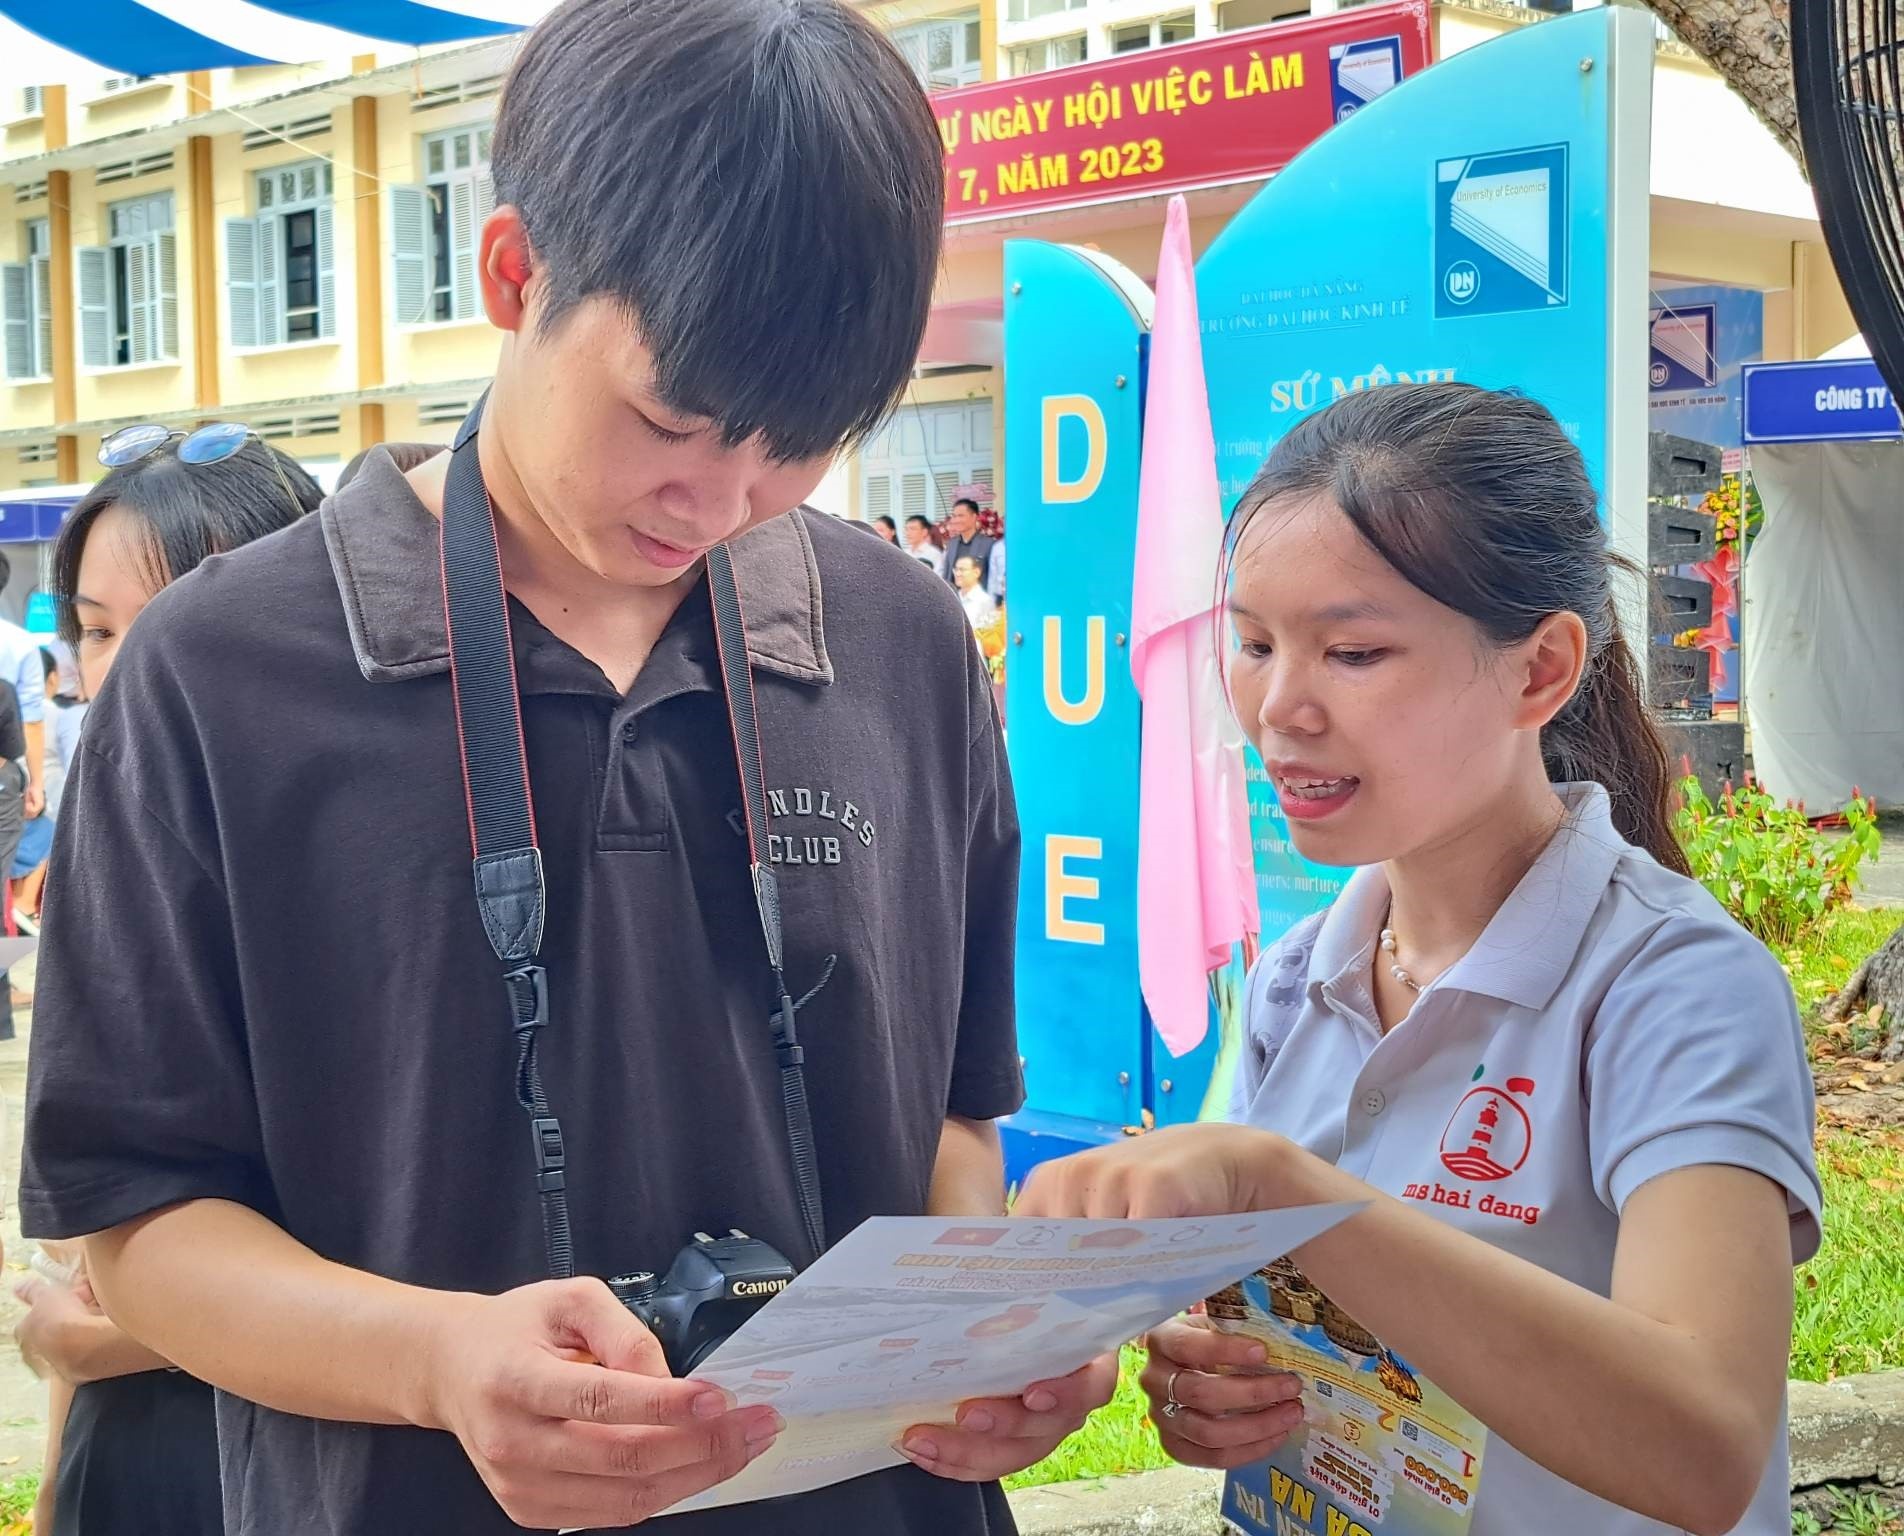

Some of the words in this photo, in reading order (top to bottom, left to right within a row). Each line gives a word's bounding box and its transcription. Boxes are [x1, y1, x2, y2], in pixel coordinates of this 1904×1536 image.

[971, 95, 1053, 144] NGÀY
[1063, 80, 1121, 130] HỘI
[1131, 65, 1213, 116] VIỆC
[1224, 51, 1304, 100] LÀM
[958, 168, 988, 205] 7,
[997, 152, 1069, 196] NĂM
[1079, 137, 1164, 184] 2023
[1456, 187, 1494, 202] University
[1495, 184, 1505, 197] of
[1504, 181, 1547, 197] Economics
[1341, 302, 1383, 320] KINH
[1270, 369, 1321, 413] SỨ
[1815, 384, 1863, 411] CÔNG
[1865, 386, 1888, 410] TY
[768, 835, 841, 864] CLUB
[1294, 876, 1341, 894] nurture
[1402, 1183, 1430, 1200] ms
[1430, 1183, 1471, 1209] hai
[1478, 1194, 1541, 1225] dang
[732, 1278, 788, 1296] Canon
[1405, 1455, 1469, 1506] 500.000
[1369, 1505, 1380, 1518] 01
